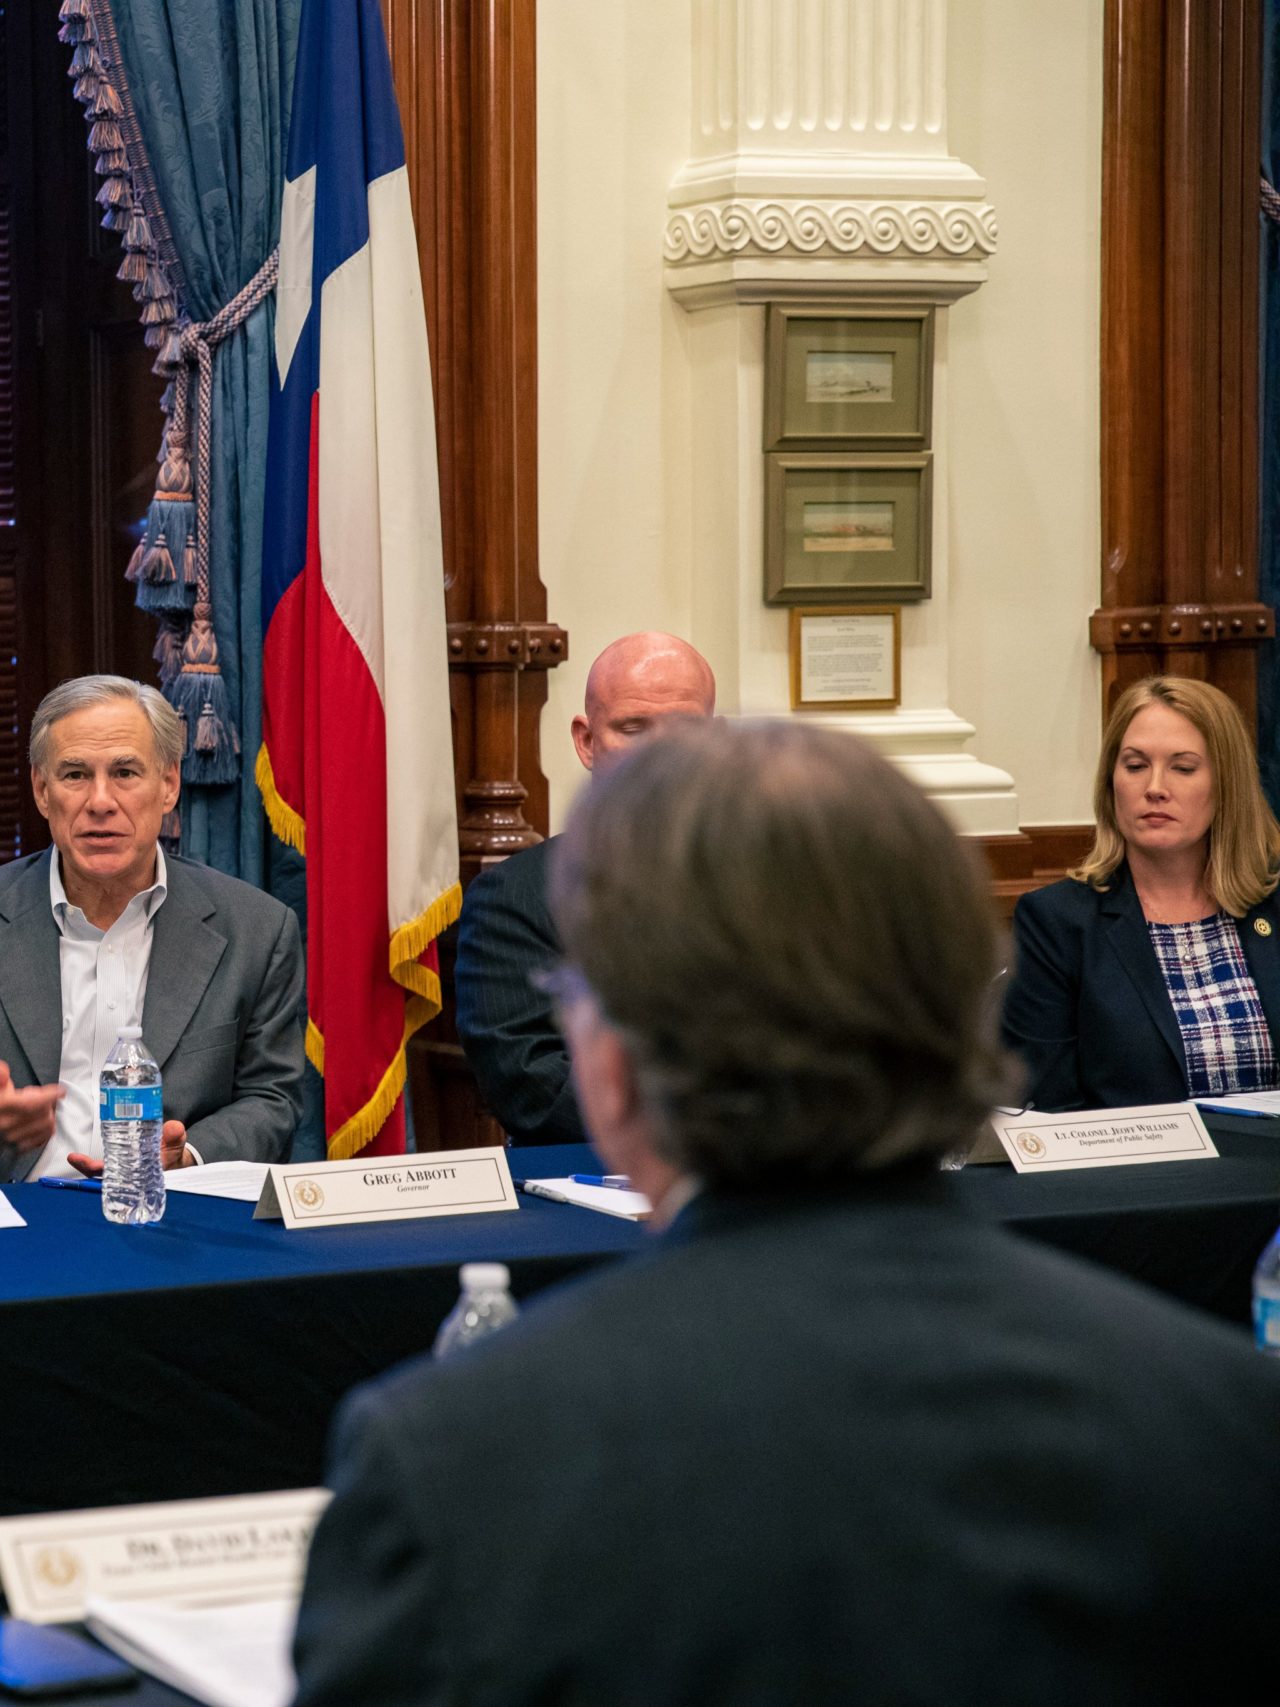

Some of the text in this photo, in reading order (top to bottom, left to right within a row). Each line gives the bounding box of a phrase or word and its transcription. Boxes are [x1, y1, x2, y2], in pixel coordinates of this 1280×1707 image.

[1070, 1128, 1110, 1139] COLONEL
[1111, 1126, 1136, 1136] JEOFF
[1136, 1122, 1180, 1132] WILLIAMS
[1079, 1133, 1164, 1147] Department of Public Safety
[362, 1168, 457, 1187] GREG ABBOTT
[396, 1184, 430, 1193] Governor
